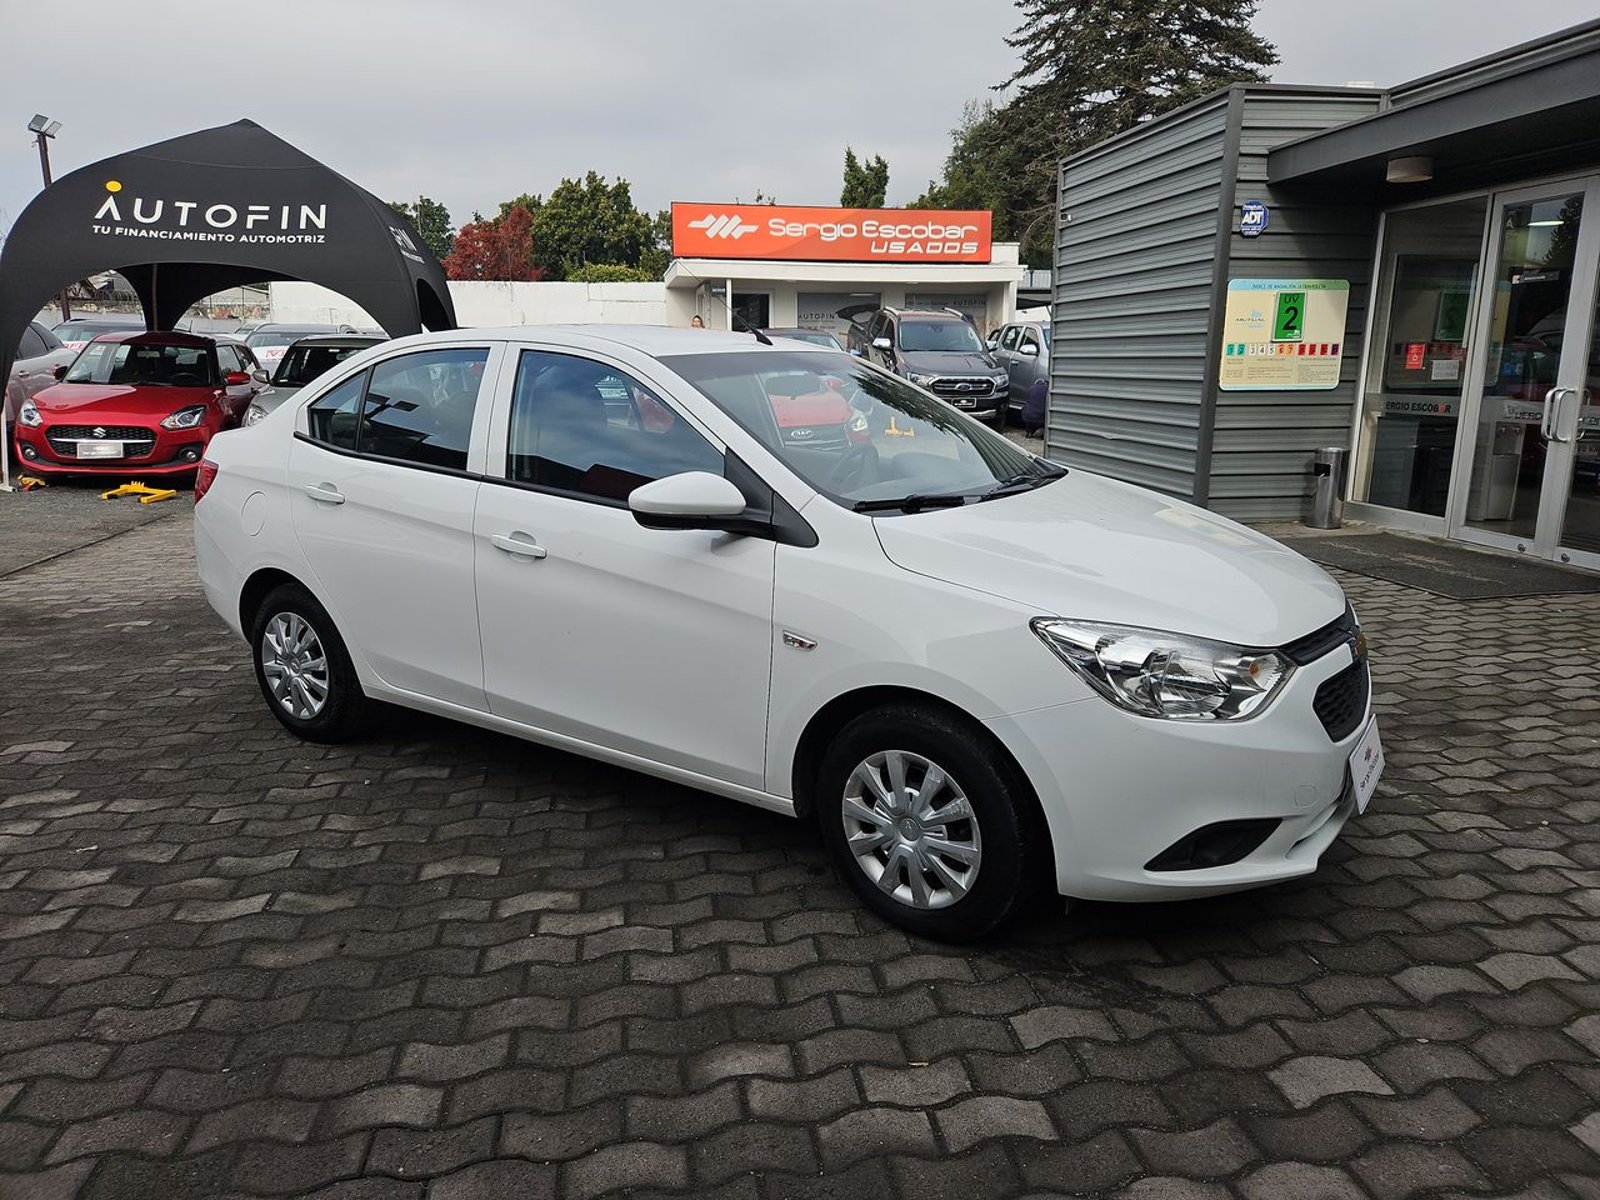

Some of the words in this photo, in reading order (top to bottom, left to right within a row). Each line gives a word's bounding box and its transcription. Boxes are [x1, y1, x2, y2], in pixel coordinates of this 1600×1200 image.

[94, 195, 327, 230] AUTOFIN
[1241, 211, 1264, 225] ADT
[92, 225, 111, 235] TU
[115, 226, 235, 243] FINANCIAMIENTO
[239, 234, 326, 244] AUTOMOTRIZ
[768, 218, 857, 241] Sergio
[862, 220, 978, 239] Escobar
[870, 241, 979, 255] USADOS
[1284, 295, 1300, 304] UV
[1282, 305, 1299, 331] 2
